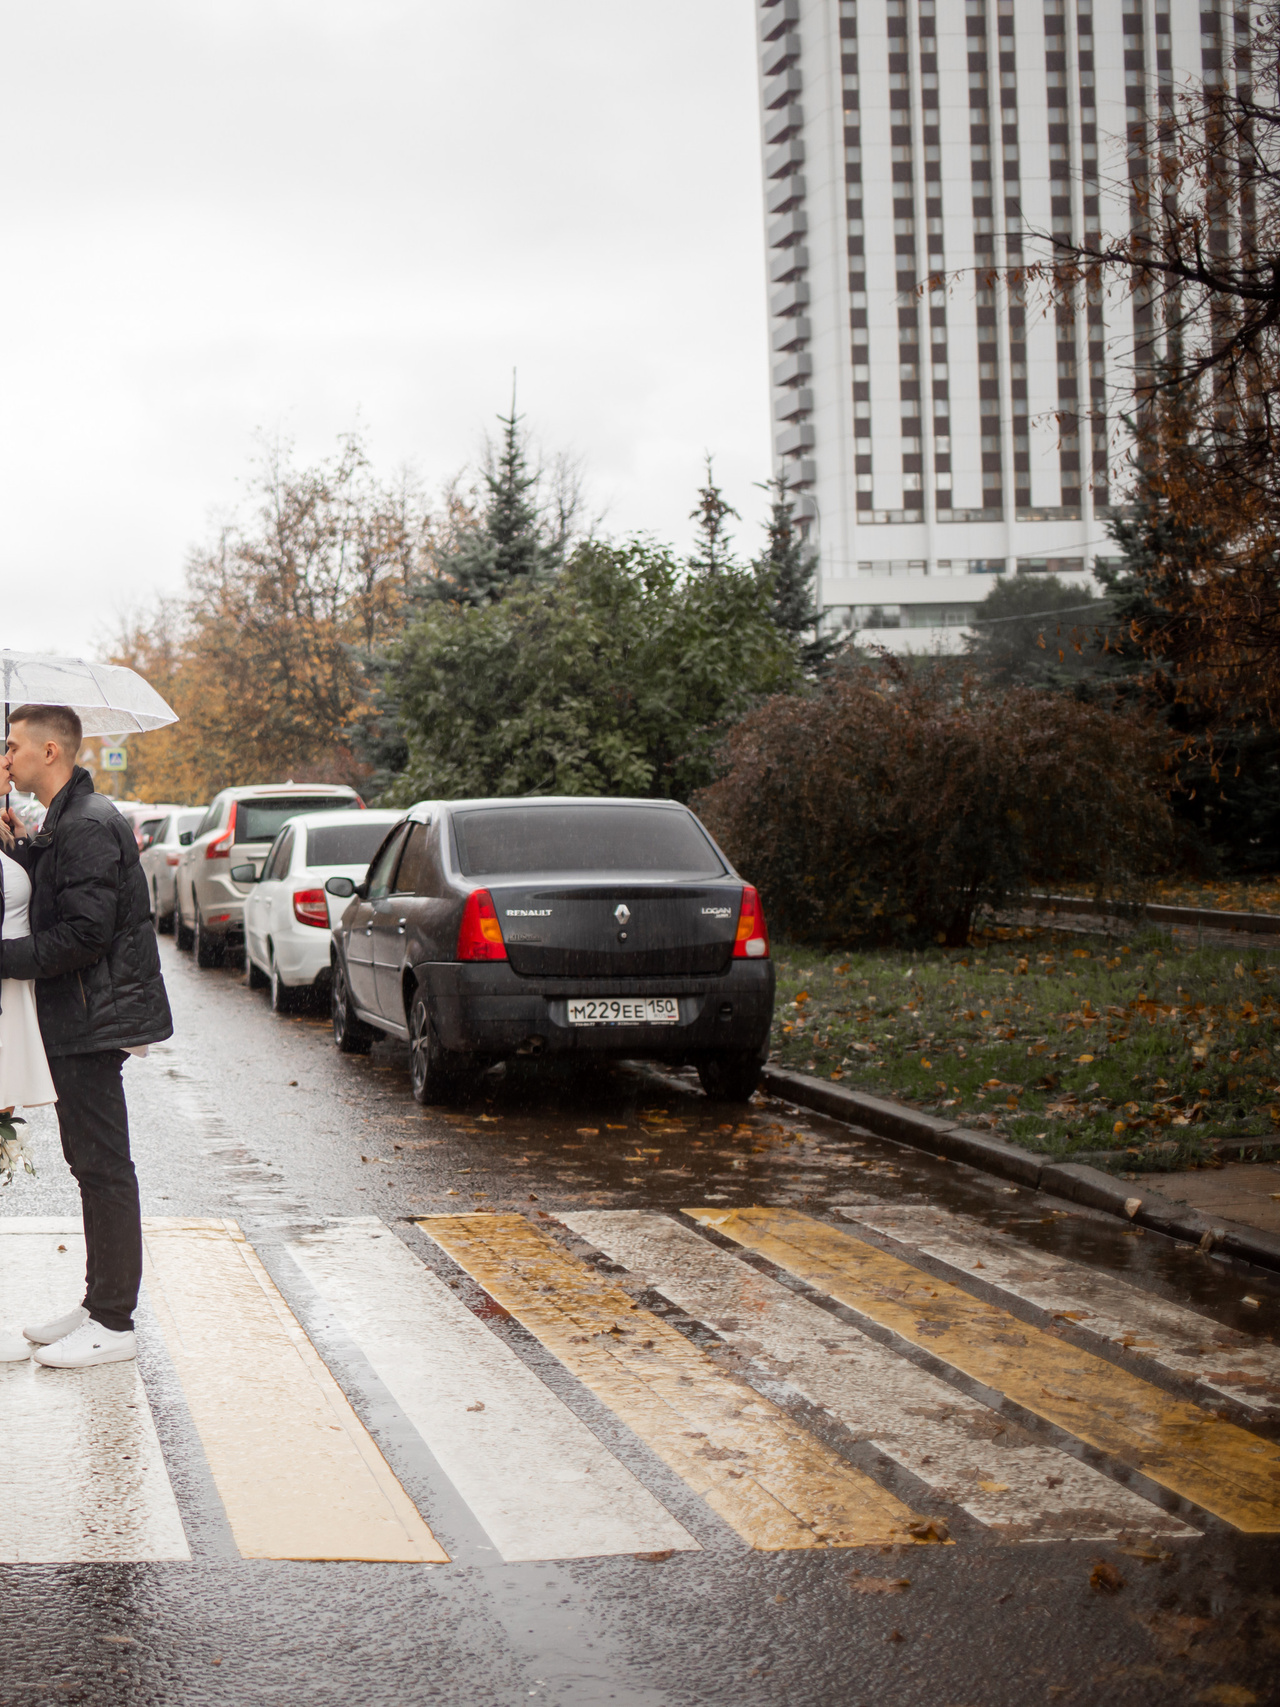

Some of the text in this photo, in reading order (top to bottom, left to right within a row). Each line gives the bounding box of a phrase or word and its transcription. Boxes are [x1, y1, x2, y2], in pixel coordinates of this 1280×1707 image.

[506, 909, 552, 917] RENAULT
[701, 907, 731, 915] LOGAN
[574, 999, 673, 1019] М229ЕЕ 150
